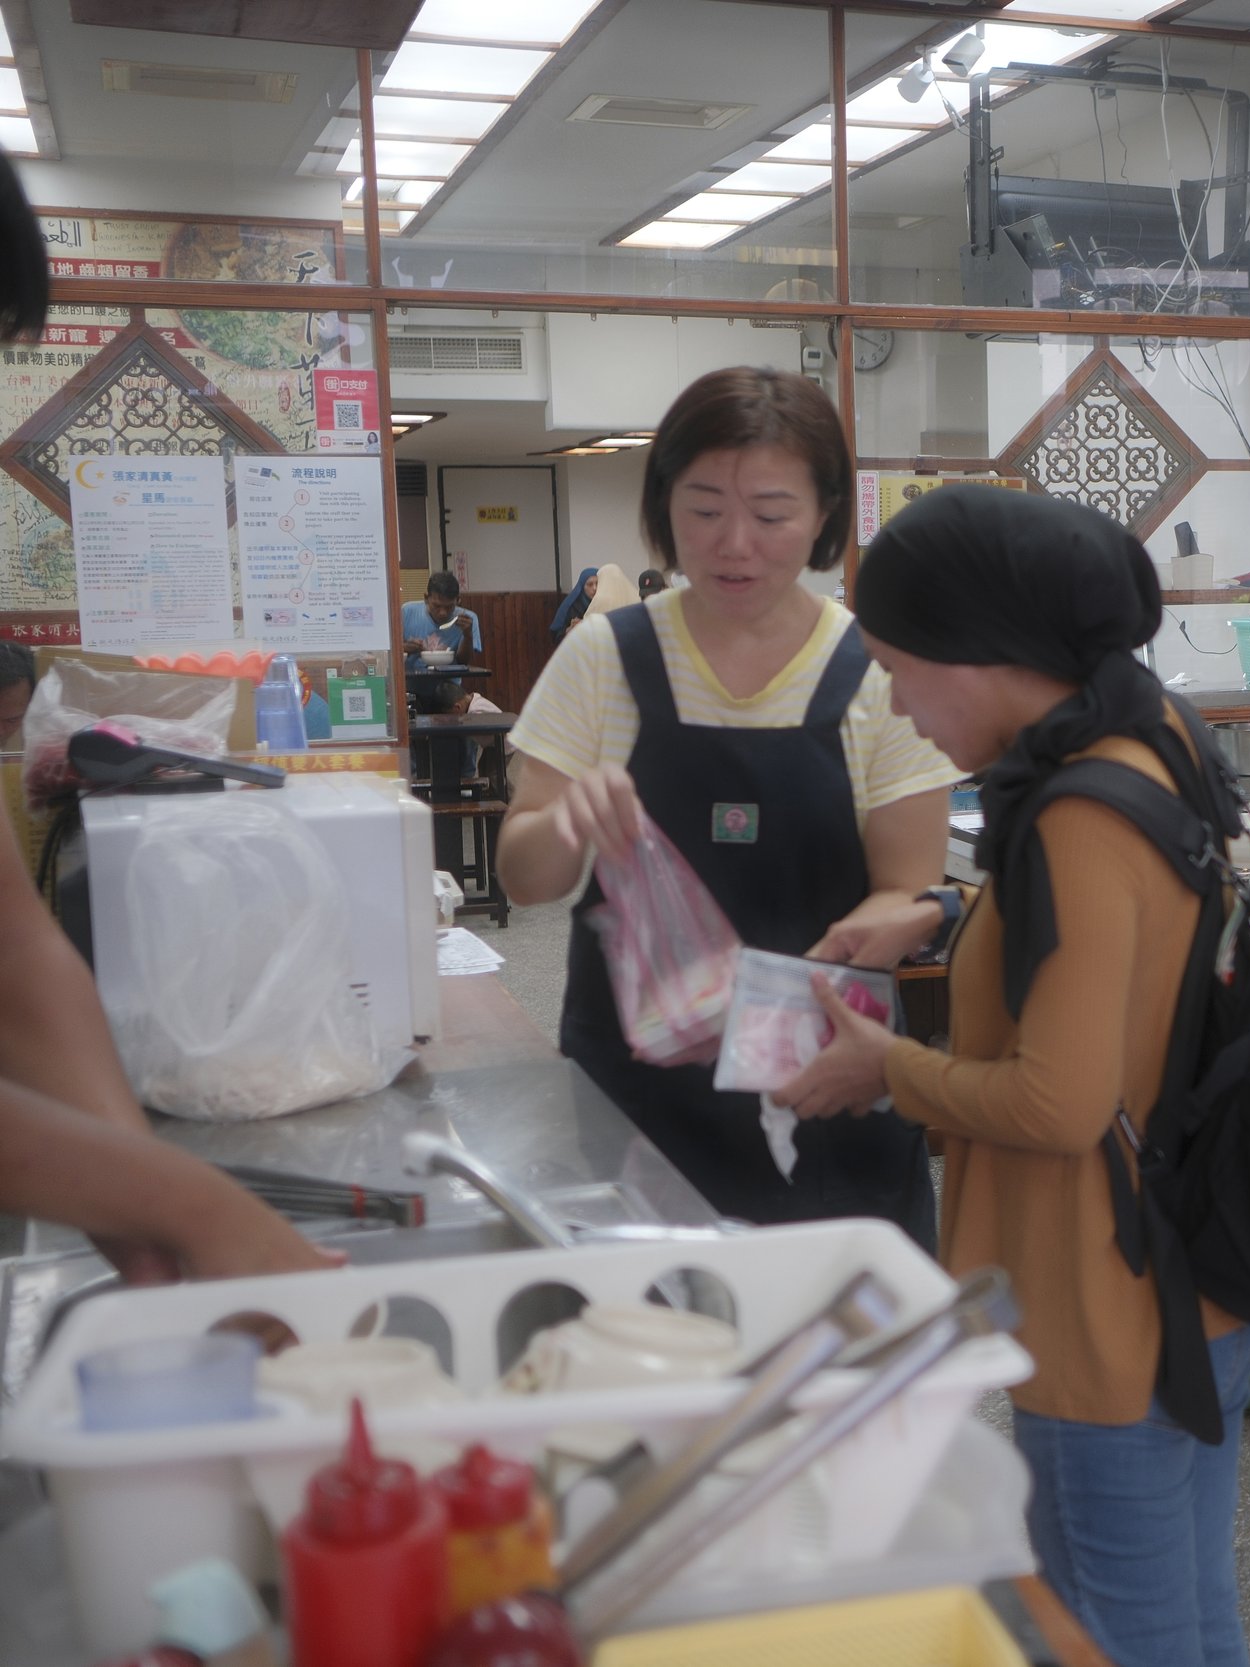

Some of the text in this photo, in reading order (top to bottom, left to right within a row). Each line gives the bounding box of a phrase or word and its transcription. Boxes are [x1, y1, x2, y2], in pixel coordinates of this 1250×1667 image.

[292, 468, 336, 479] 流程說明
[861, 476, 875, 541] 請勿攜帶外食進入
